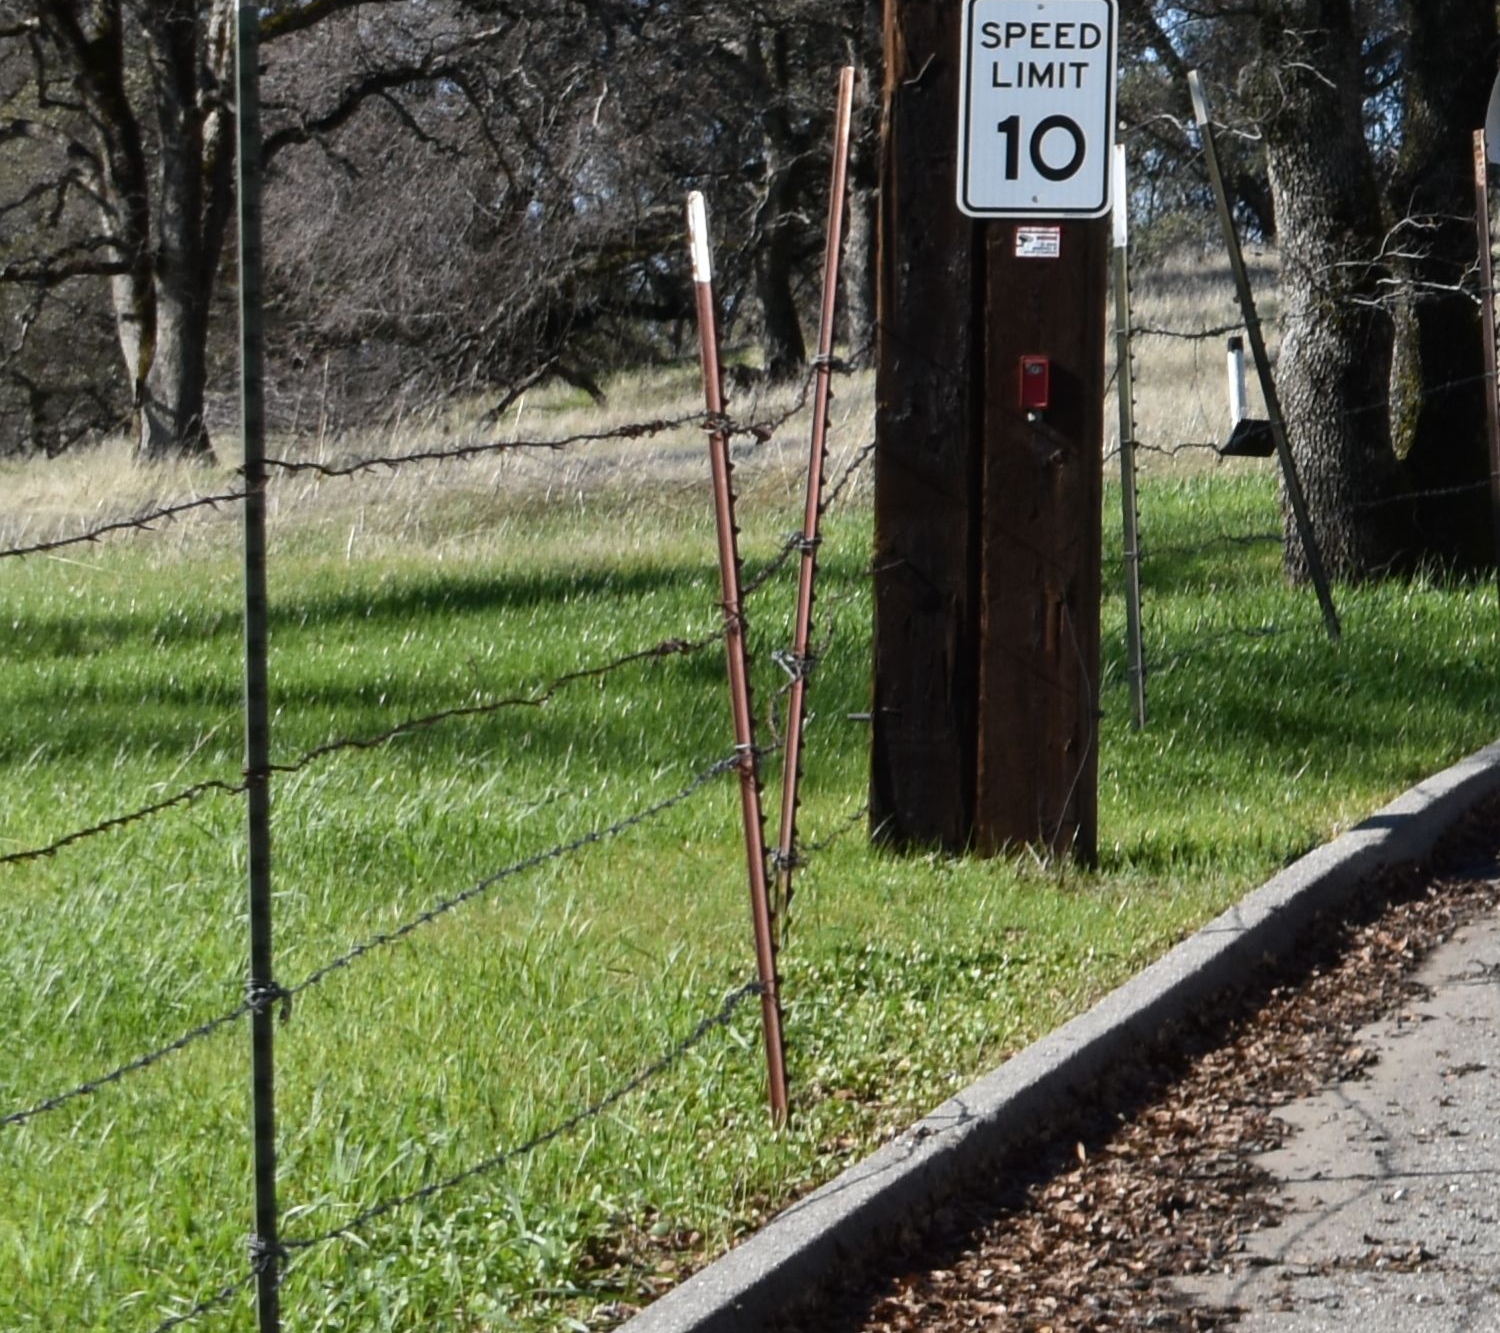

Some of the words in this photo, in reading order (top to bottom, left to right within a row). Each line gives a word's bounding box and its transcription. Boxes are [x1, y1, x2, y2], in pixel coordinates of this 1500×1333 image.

[981, 21, 1102, 49] SPEED
[992, 61, 1089, 89] LIMIT
[997, 114, 1086, 182] 10
